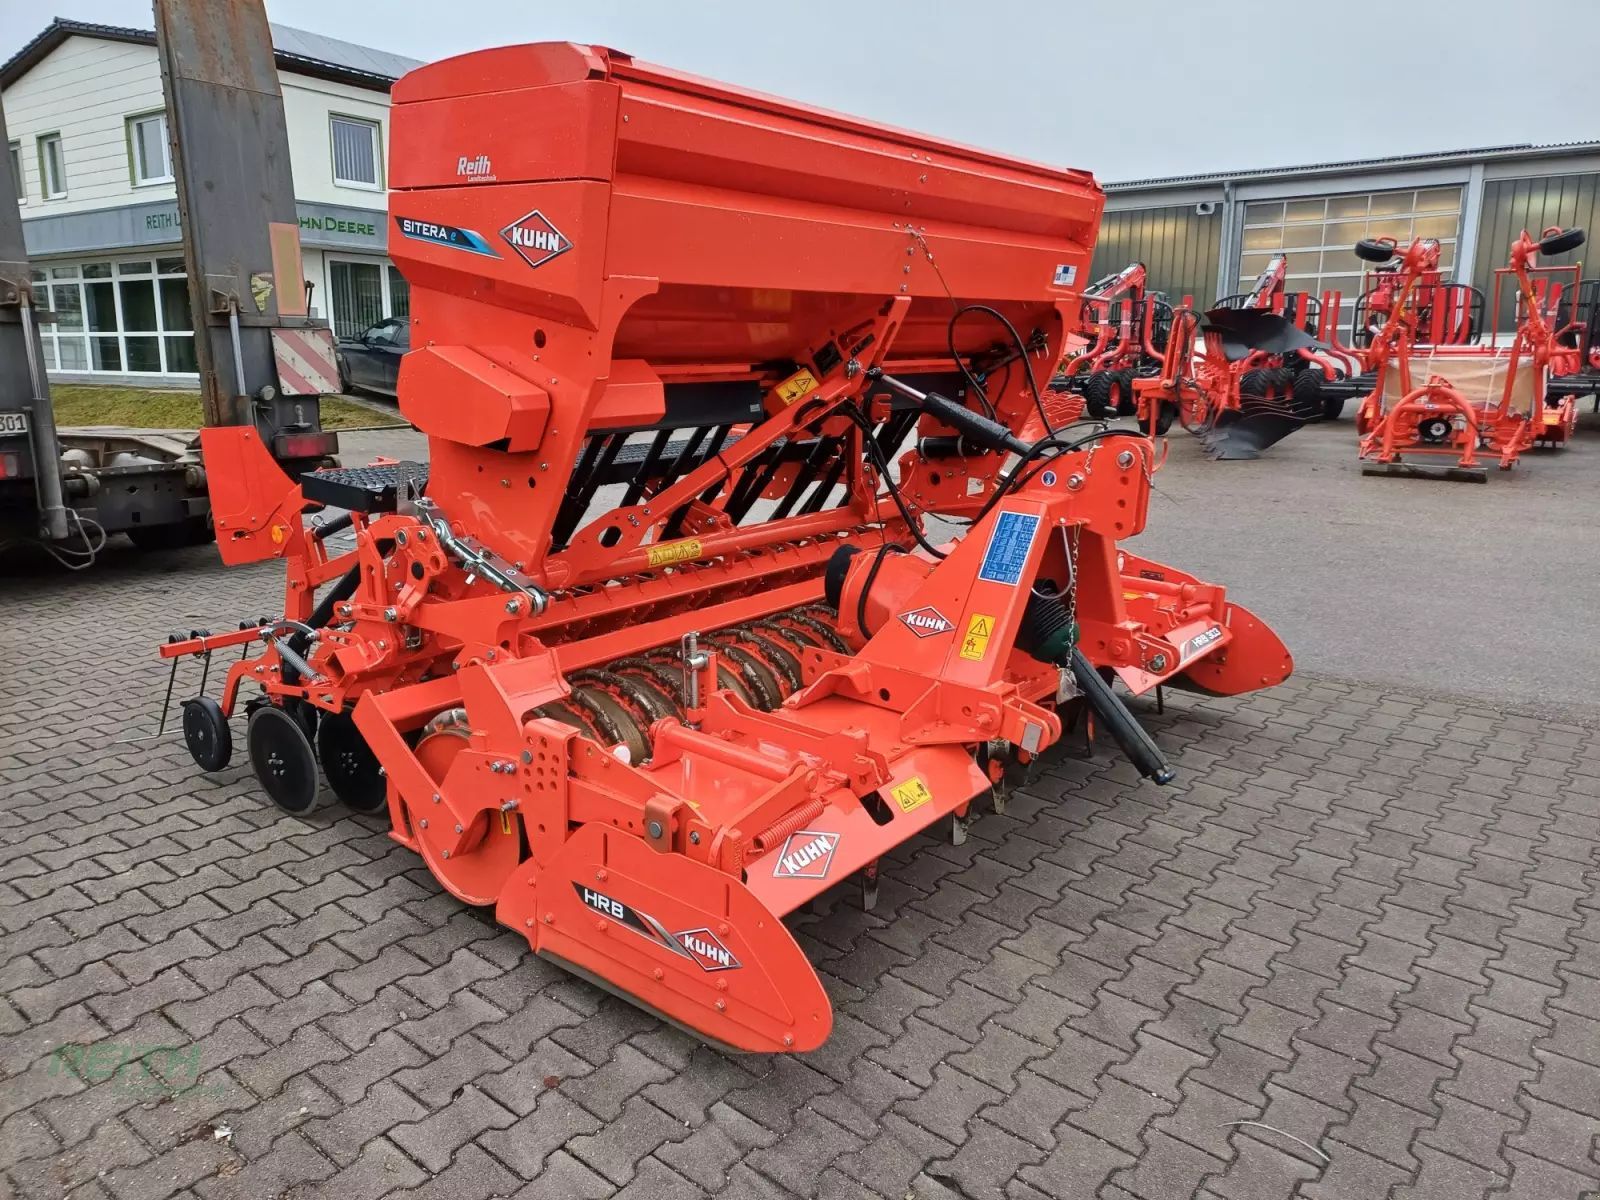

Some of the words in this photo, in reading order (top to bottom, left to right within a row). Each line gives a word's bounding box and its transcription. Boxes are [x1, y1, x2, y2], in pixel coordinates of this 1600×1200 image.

[457, 155, 491, 176] Reith
[146, 213, 171, 229] REITH
[324, 216, 375, 236] DEERE
[403, 219, 447, 240] SITERA
[512, 226, 560, 252] KUHN
[906, 613, 946, 631] KUHN
[782, 835, 833, 875] KUHN
[584, 888, 624, 920] HRB
[684, 934, 730, 967] KUHN
